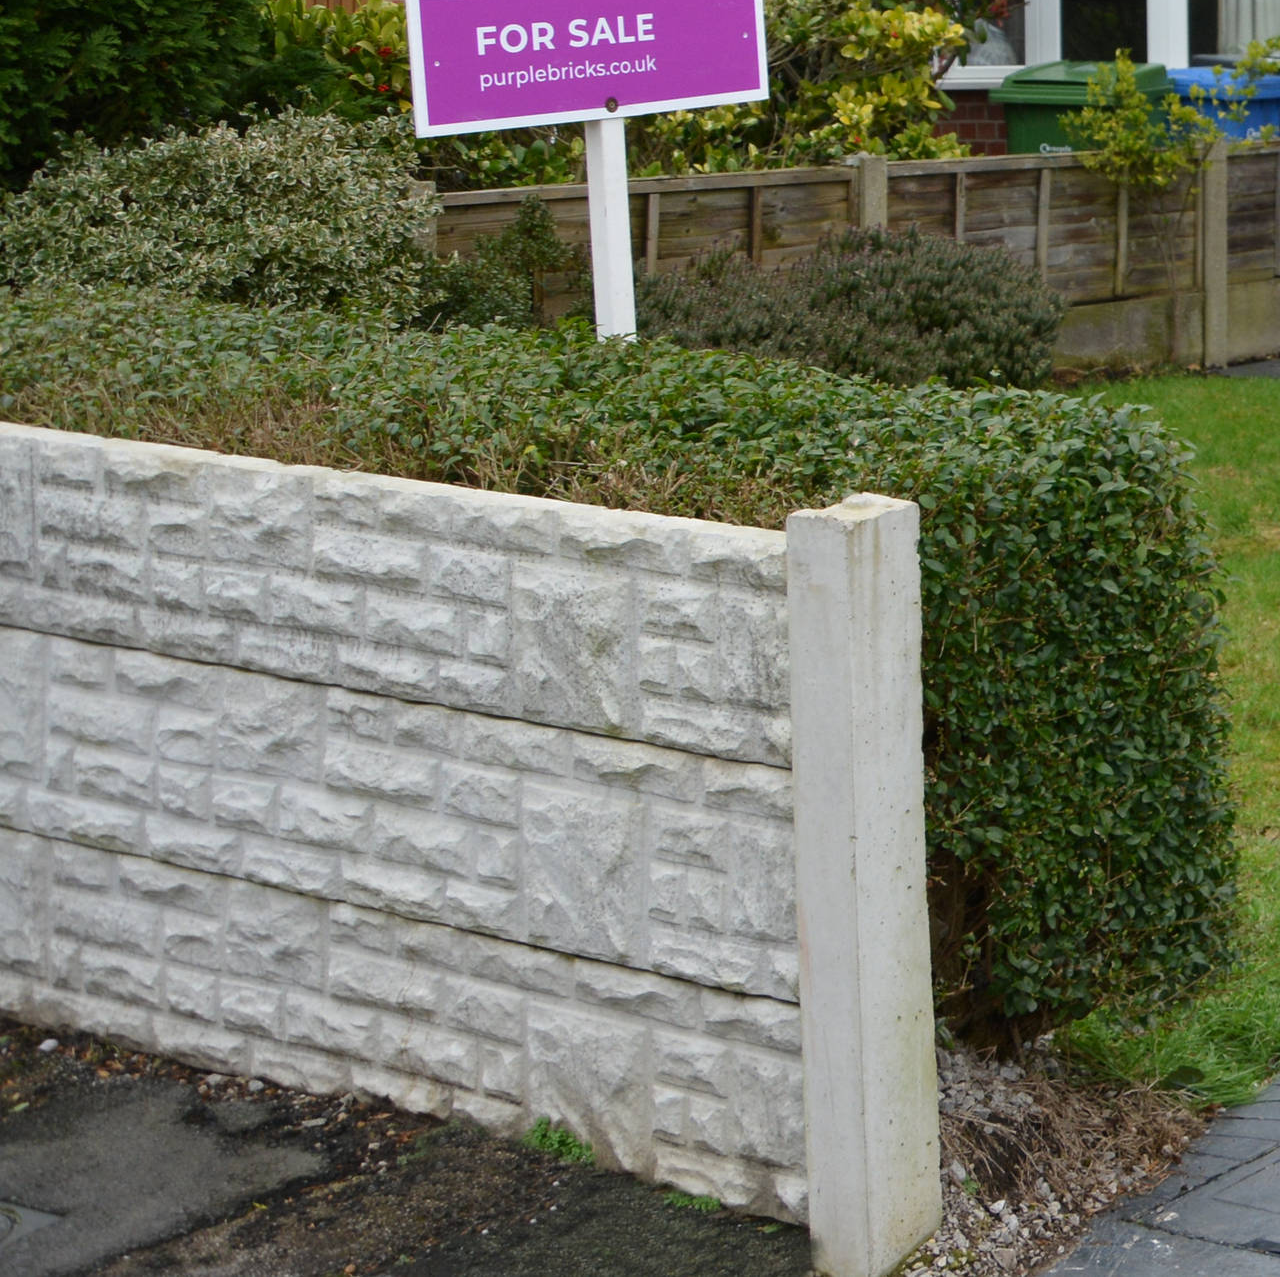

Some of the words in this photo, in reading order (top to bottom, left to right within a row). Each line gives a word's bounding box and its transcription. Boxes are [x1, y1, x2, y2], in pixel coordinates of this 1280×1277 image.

[476, 21, 556, 56] FOR
[568, 13, 656, 48] SALE
[479, 54, 657, 91] purplebricks.co.uk
